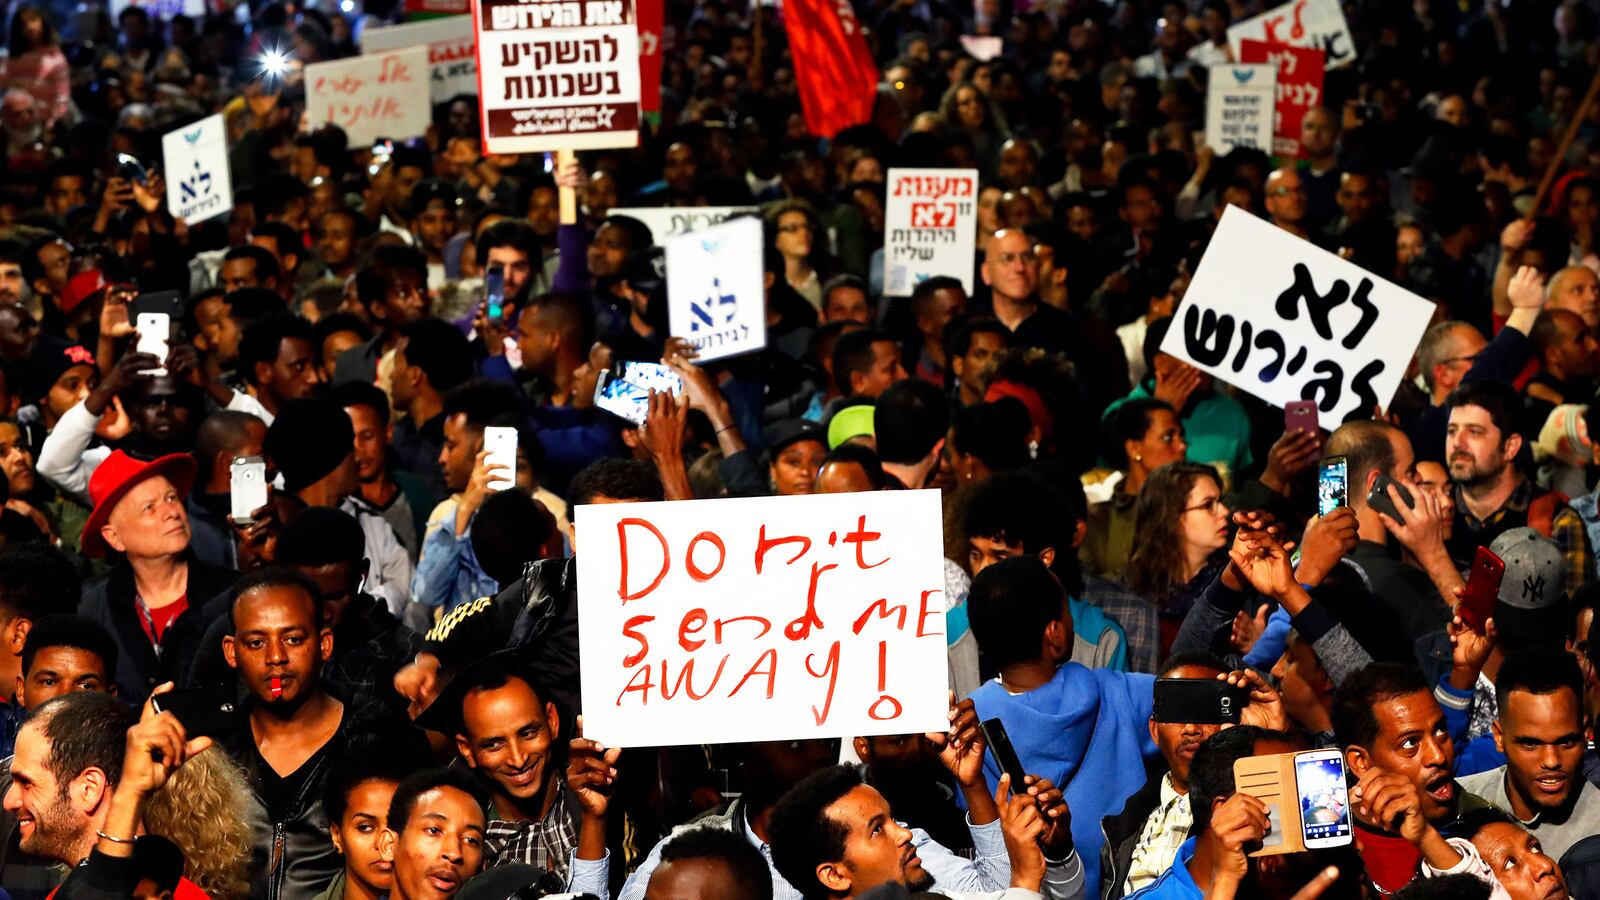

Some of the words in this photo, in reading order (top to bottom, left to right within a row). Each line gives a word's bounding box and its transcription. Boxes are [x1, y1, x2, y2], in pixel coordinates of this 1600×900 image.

[491, 3, 581, 30] הגירוש
[585, 1, 623, 26] את
[501, 34, 618, 70] להשקיע
[504, 71, 621, 100] בשכונות
[180, 160, 211, 203] לא
[893, 176, 973, 199] גזענות
[914, 197, 956, 227] לא
[892, 229, 956, 243] היהדות
[690, 277, 736, 332] לא
[1275, 262, 1379, 350] לא
[1184, 304, 1385, 424] לגירוש
[852, 589, 945, 638] ME
